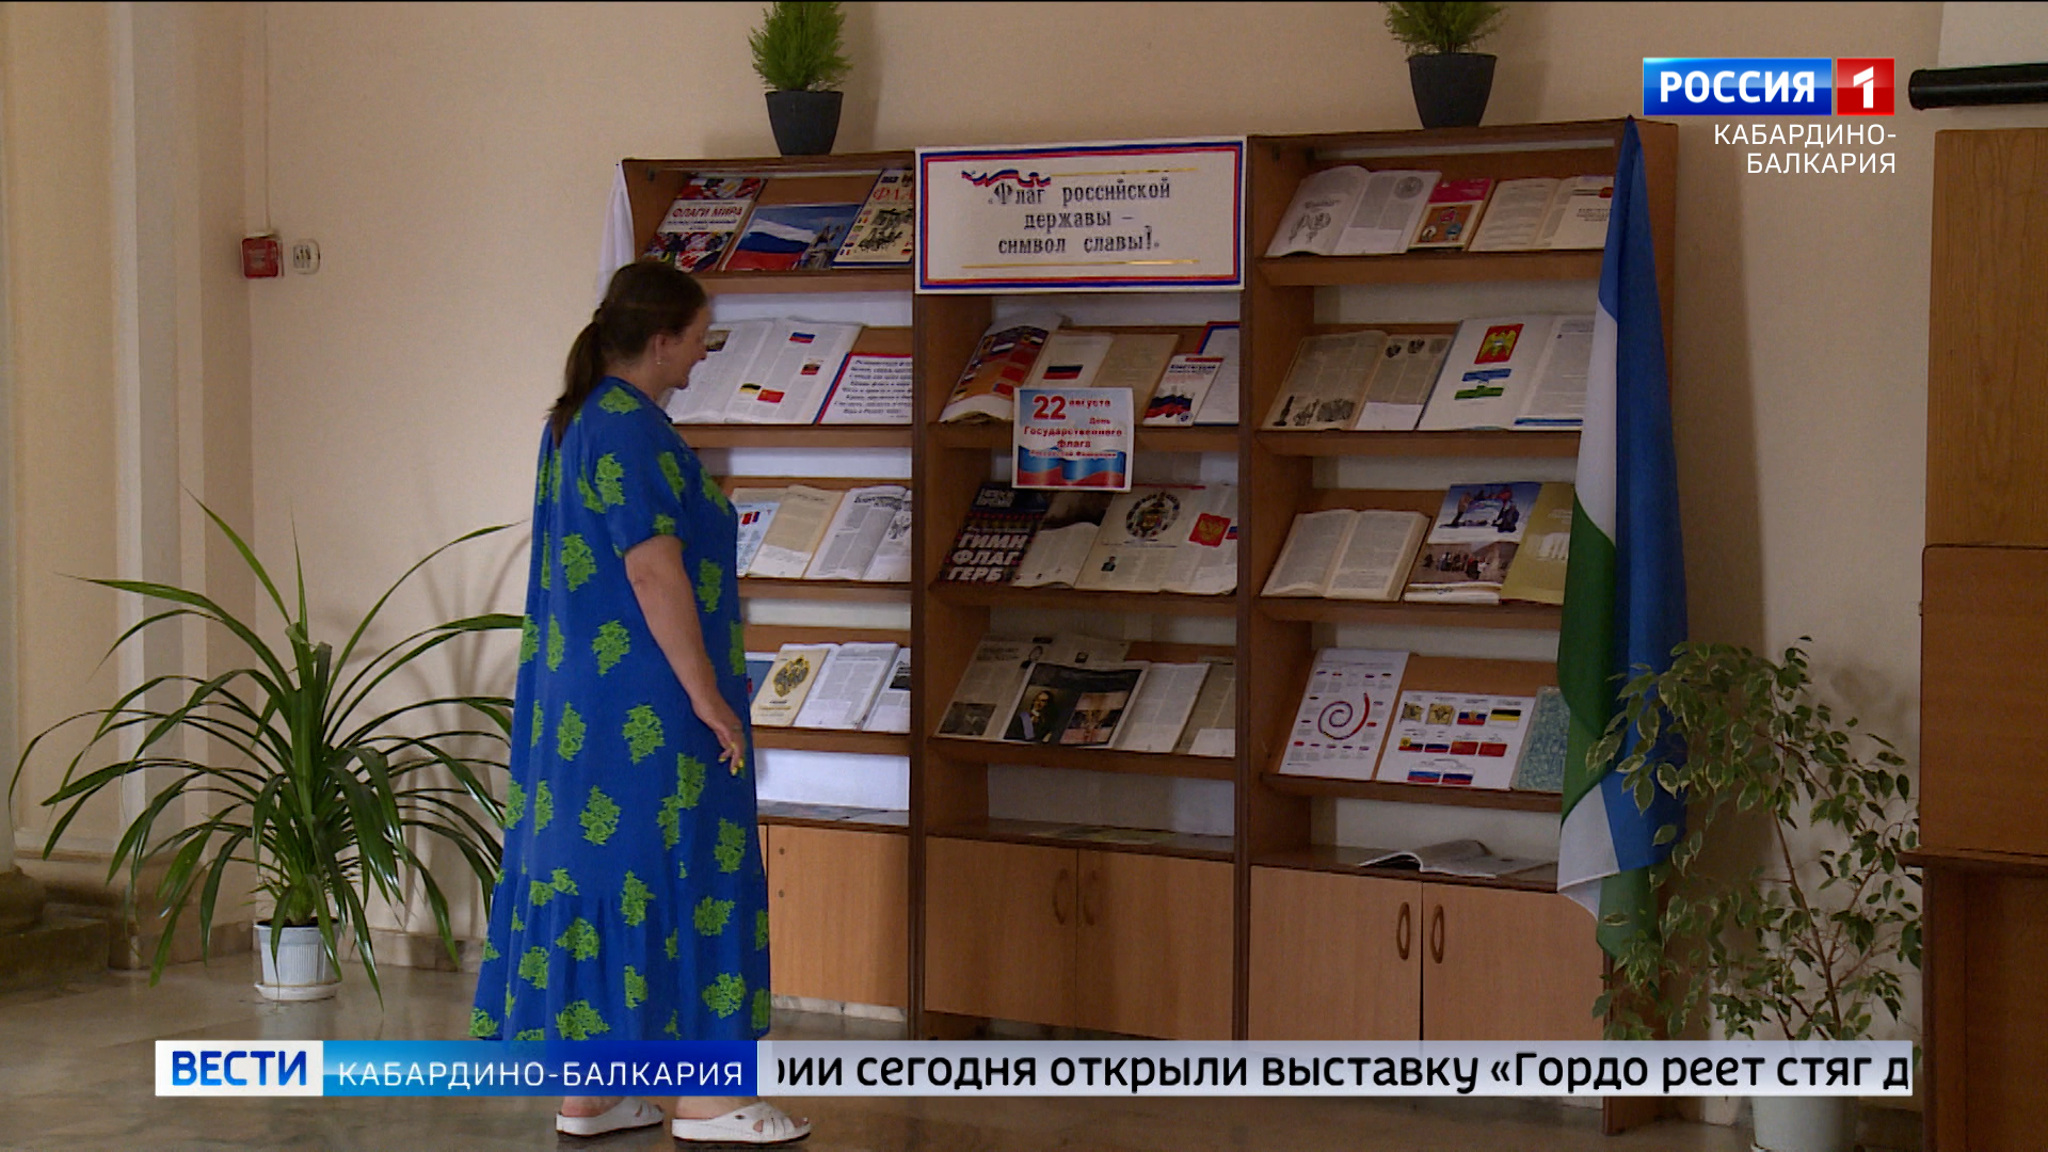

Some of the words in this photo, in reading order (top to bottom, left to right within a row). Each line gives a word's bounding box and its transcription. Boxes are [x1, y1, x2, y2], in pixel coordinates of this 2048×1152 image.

[1062, 177, 1170, 207] российской
[711, 206, 743, 217] МИРА
[1024, 211, 1112, 234] державы
[998, 237, 1066, 254] символ
[1033, 395, 1066, 420] 22
[1069, 400, 1111, 409] августа
[1089, 417, 1111, 425] День
[1024, 426, 1122, 437] Государственного
[958, 534, 1028, 549] ГИМН
[952, 550, 1020, 566] ФЛАГ
[947, 567, 1004, 582] ГЕРБ
